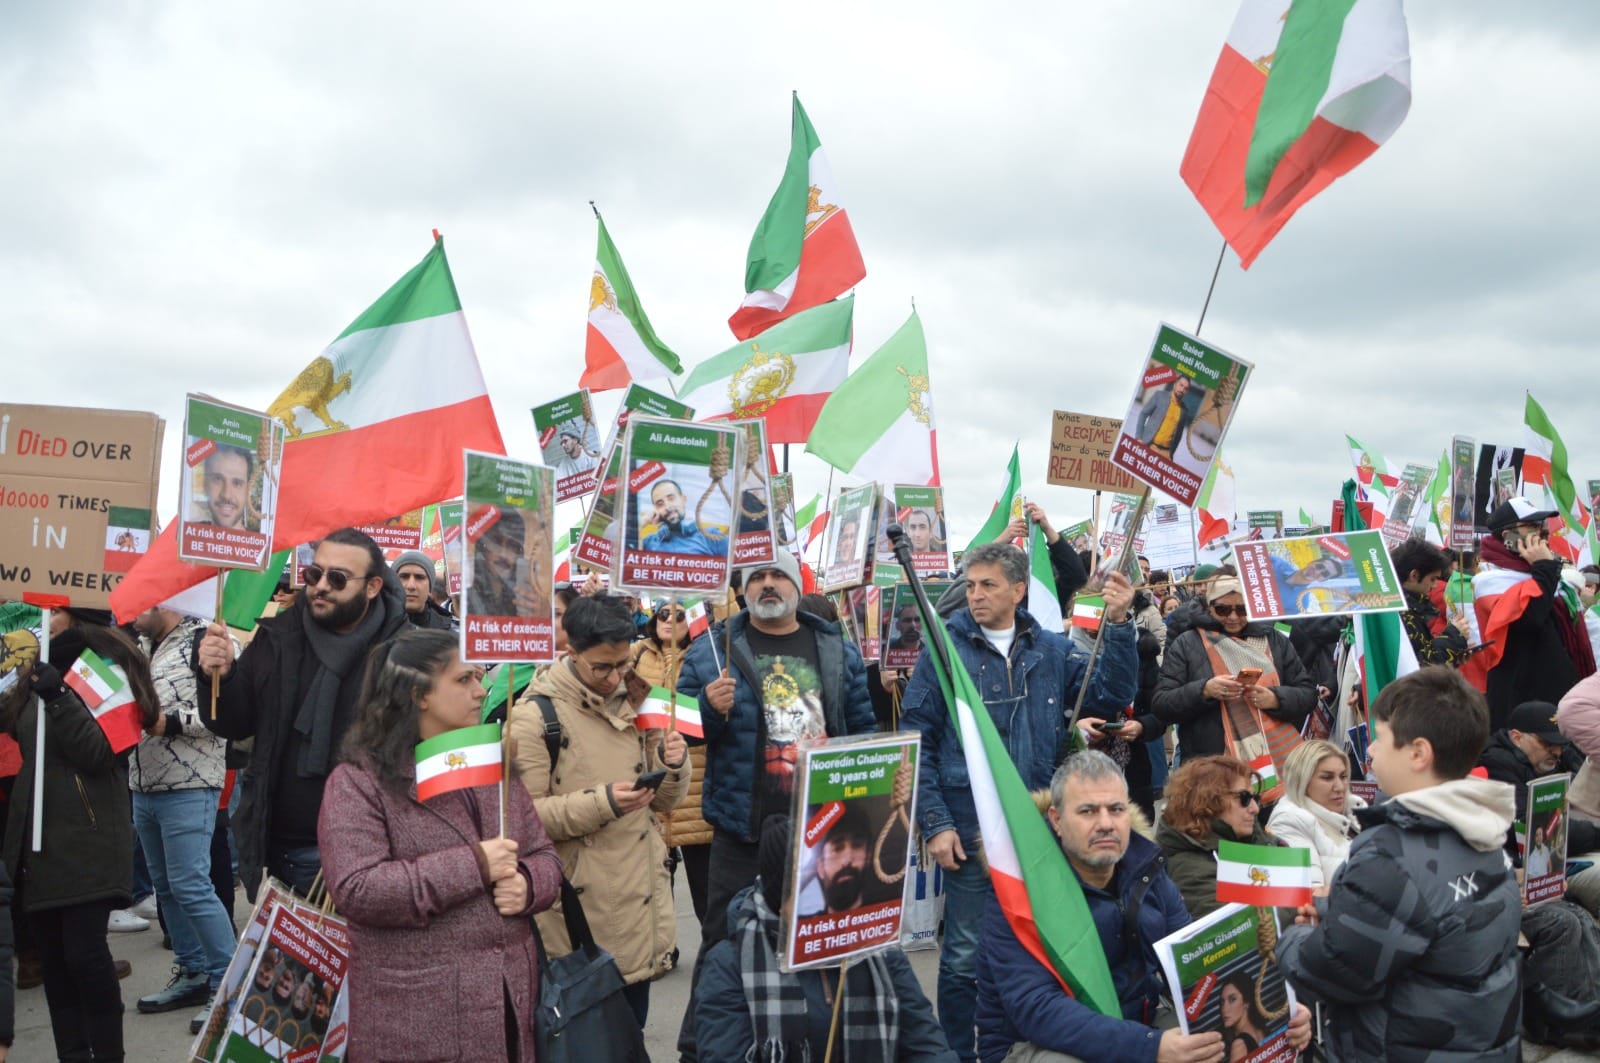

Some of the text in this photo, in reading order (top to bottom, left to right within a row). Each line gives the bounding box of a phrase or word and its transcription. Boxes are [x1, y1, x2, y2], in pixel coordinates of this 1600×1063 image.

[1144, 369, 1173, 383] Detained
[222, 418, 240, 429] Amin
[1090, 417, 1102, 427] do
[208, 424, 253, 443] Pour Farhang
[649, 432, 708, 448] Ali Asadolahi
[1063, 425, 1114, 444] REGIME
[72, 440, 131, 460] OVER
[187, 441, 213, 462] Detained
[1080, 445, 1090, 455] do
[1049, 455, 1082, 481] REZA
[1121, 438, 1199, 490] At risk of execution
[630, 463, 661, 487] Detained
[1122, 452, 1190, 499] BE THEIR VOICE
[566, 484, 583, 495] THEIR
[467, 506, 497, 536] Detained
[185, 526, 265, 546] At risk of execution
[385, 528, 419, 537] execution
[392, 538, 415, 546] VOICE
[584, 536, 595, 546] At
[735, 535, 770, 546] ecution
[191, 540, 260, 559] BE THEIR VOICE
[586, 548, 599, 559] BE
[735, 547, 766, 558] VOICE
[1321, 537, 1350, 557] Detained
[626, 553, 726, 570] At risk of execution
[0, 563, 31, 583] WO
[633, 568, 720, 584] BE THEIR VOICE
[1242, 550, 1254, 562] BE
[1251, 586, 1266, 613] VOICE
[1254, 545, 1279, 616] At risk of execution
[468, 620, 552, 635] At risk of execution
[475, 639, 549, 652] BE THEIR VOICE
[811, 756, 855, 771] Nooredin
[828, 767, 885, 785] 30 years old
[806, 802, 840, 840] Detained
[280, 916, 305, 939] VOICE
[798, 906, 900, 937] At risk of execution
[804, 922, 893, 954] BE THEIR VOICE
[1182, 918, 1253, 964] Shakila Ghasemi
[272, 927, 341, 986] At risk of execution
[306, 937, 329, 960] THEIR
[1202, 942, 1237, 967] Kerman
[329, 957, 341, 969] BE
[1187, 975, 1213, 1014] Detained
